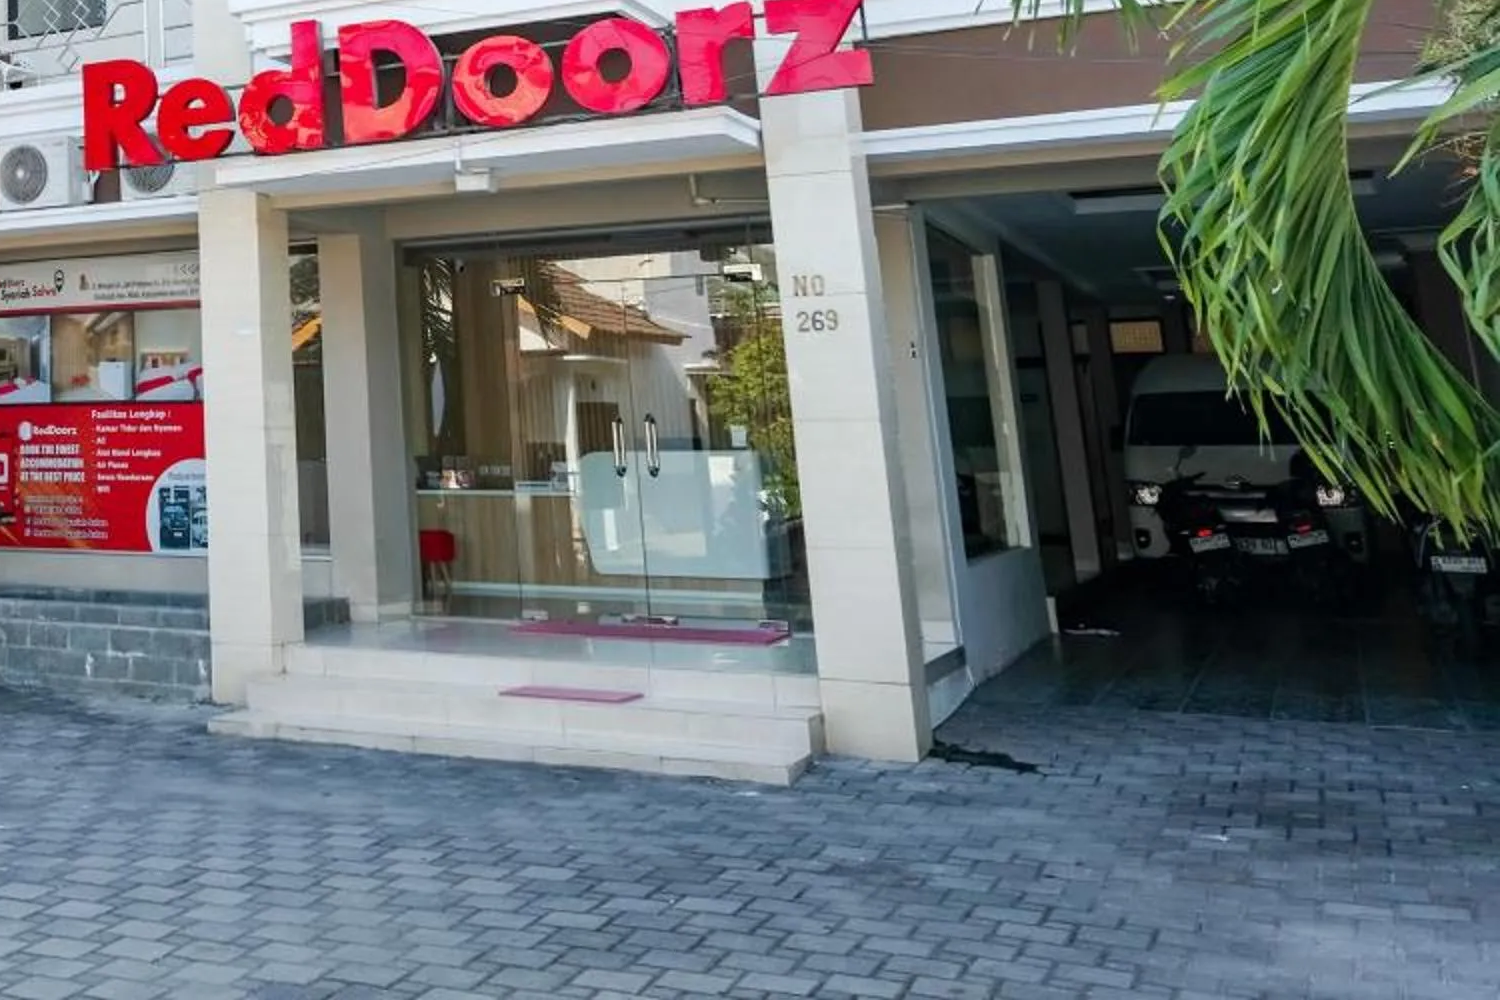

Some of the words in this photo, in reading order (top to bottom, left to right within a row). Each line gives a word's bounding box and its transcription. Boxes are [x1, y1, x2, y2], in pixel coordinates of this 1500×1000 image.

[791, 274, 826, 297] NO
[796, 309, 839, 333] 269
[33, 425, 77, 435] RedDoorz
